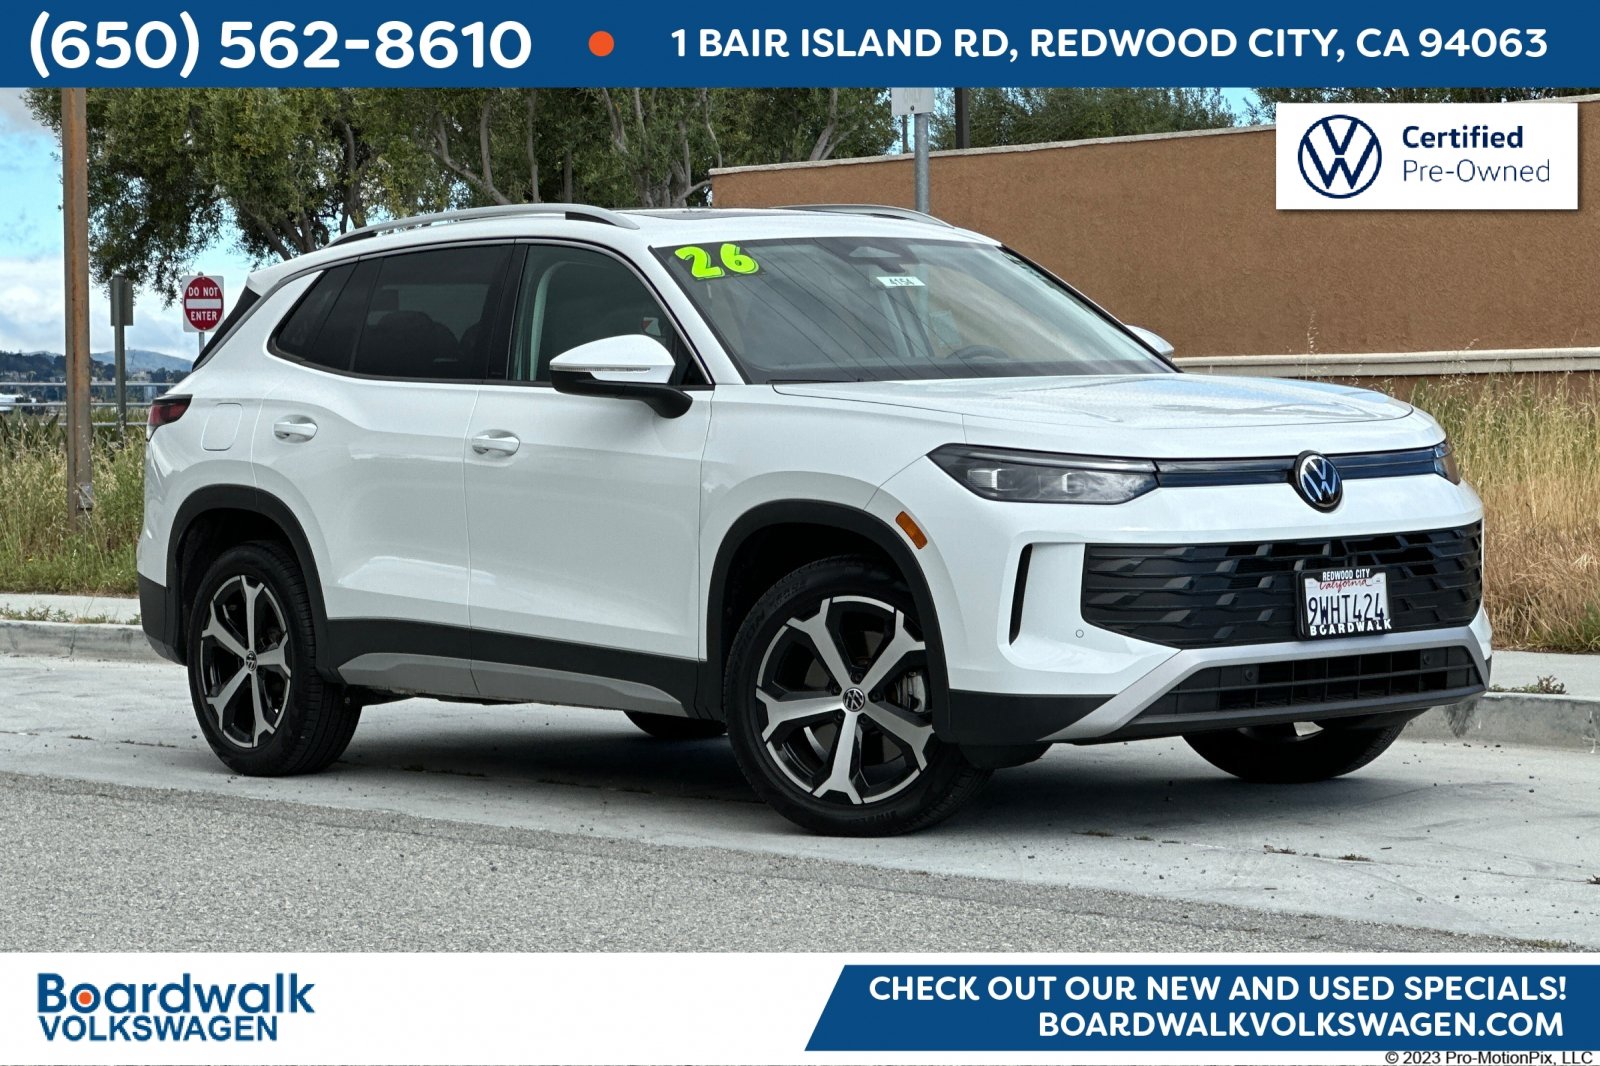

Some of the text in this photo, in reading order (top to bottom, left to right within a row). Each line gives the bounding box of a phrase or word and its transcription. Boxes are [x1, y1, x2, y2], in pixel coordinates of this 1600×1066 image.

[674, 243, 760, 280] 26
[188, 286, 219, 297] DO NOT
[190, 311, 218, 321] ENTER
[1322, 568, 1371, 581] REDWOOD CITY
[1319, 579, 1373, 593] California
[1308, 592, 1385, 626] 9WHT424
